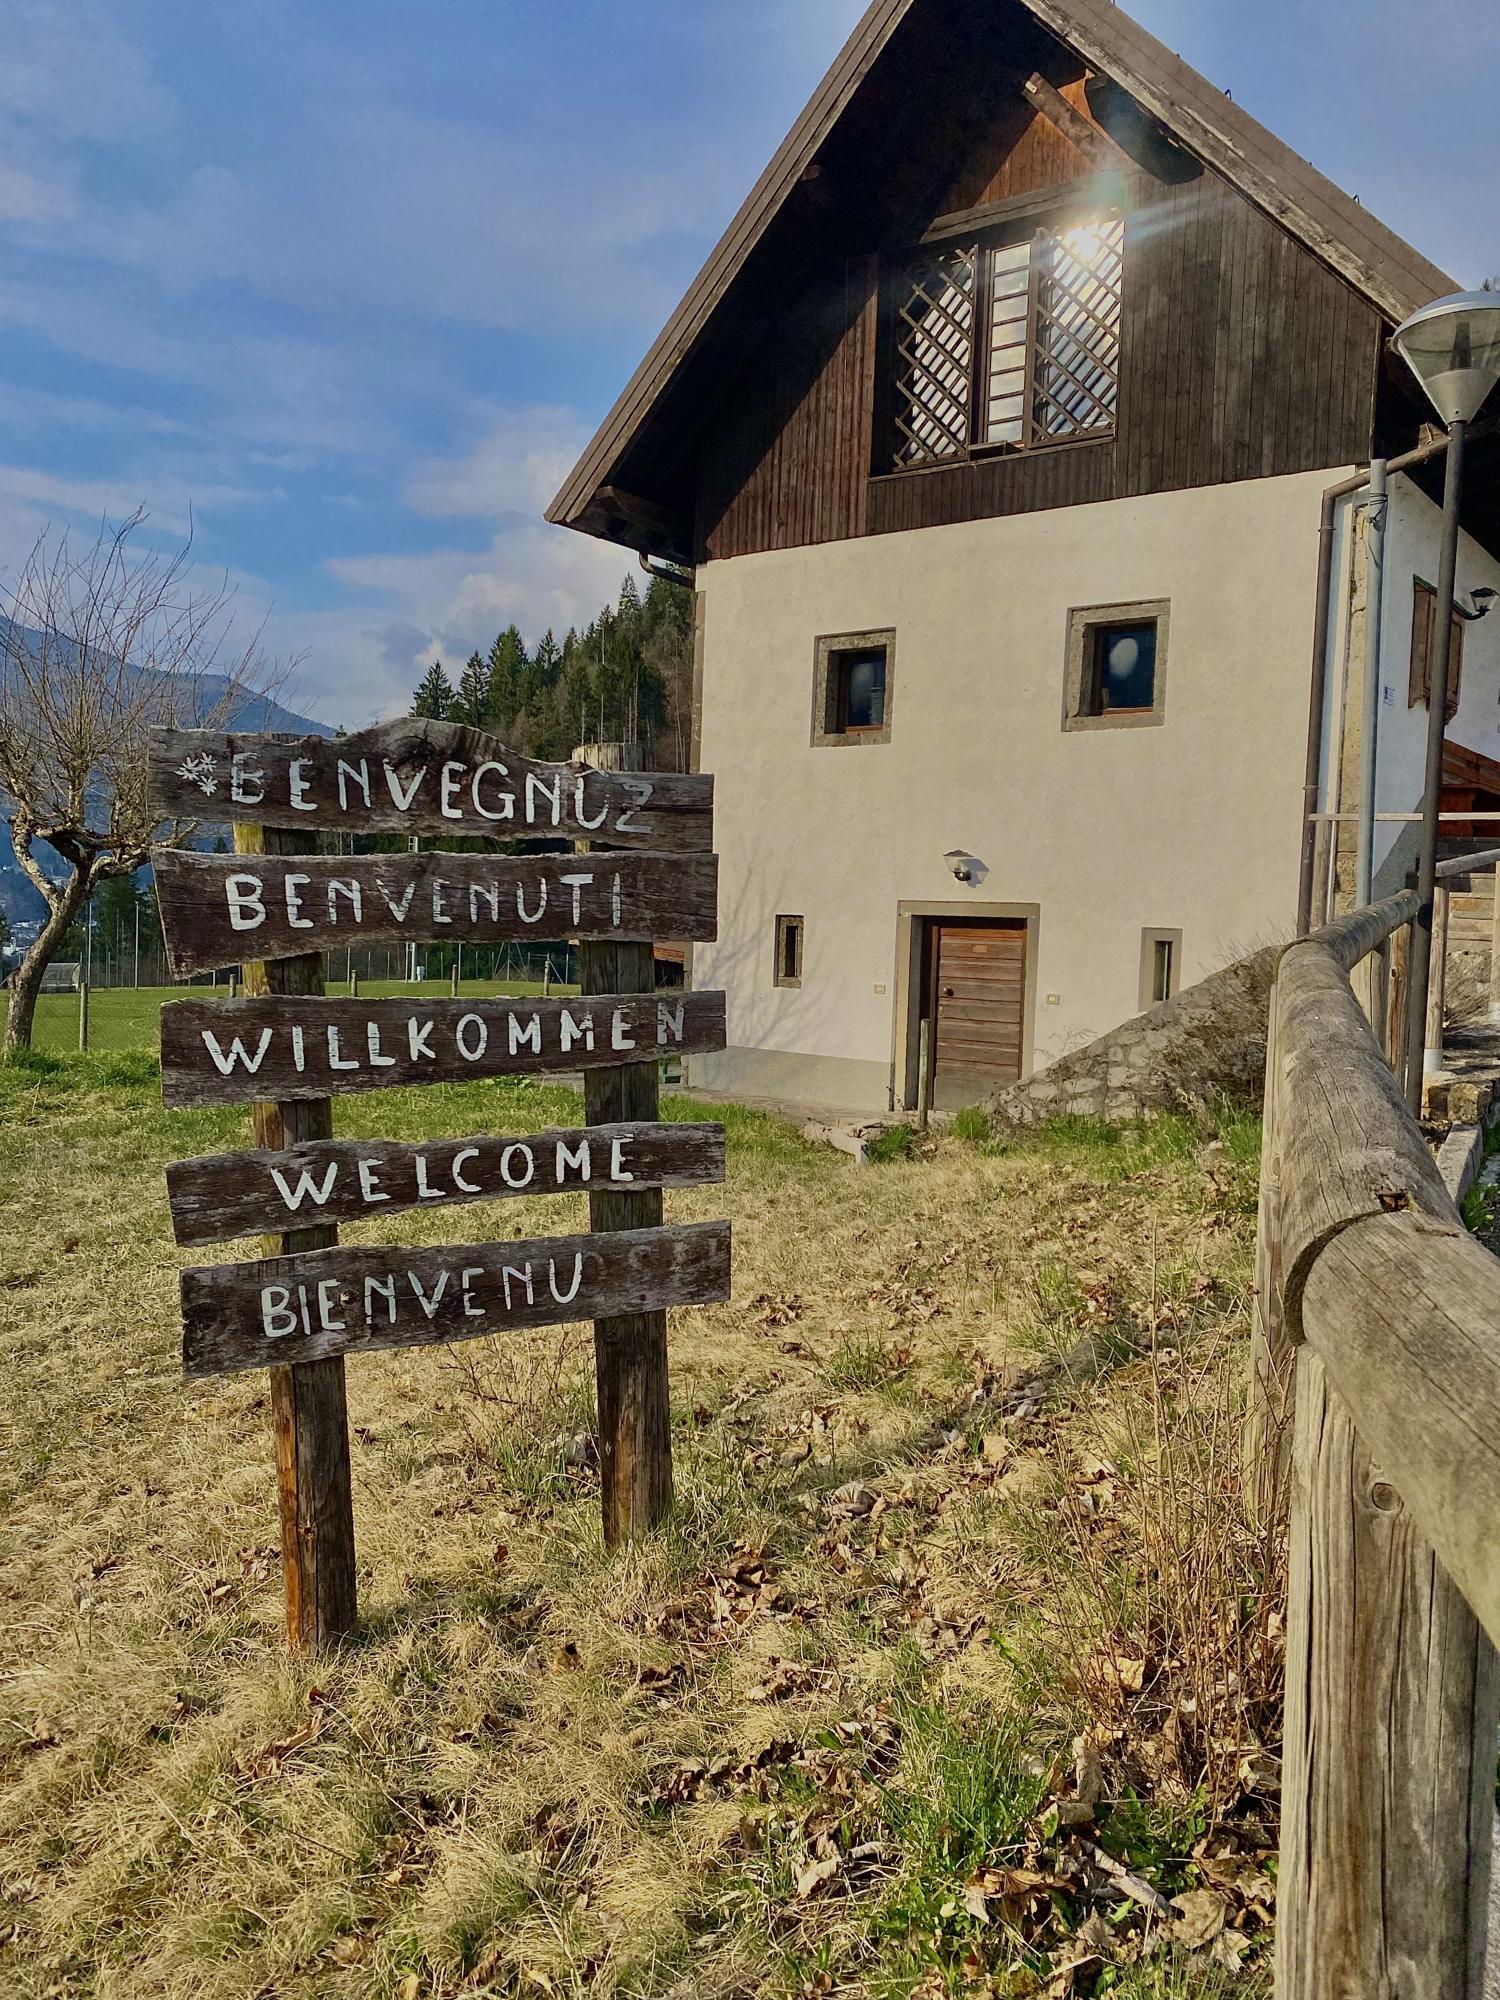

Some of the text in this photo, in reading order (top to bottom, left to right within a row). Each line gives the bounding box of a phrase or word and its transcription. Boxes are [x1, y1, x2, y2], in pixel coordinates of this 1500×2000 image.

[224, 873, 622, 931] BENVENUTI
[201, 1002, 684, 1075] WILLKOMMEN
[270, 1133, 635, 1211] WELCOME
[261, 1251, 583, 1338] BIENVENU
